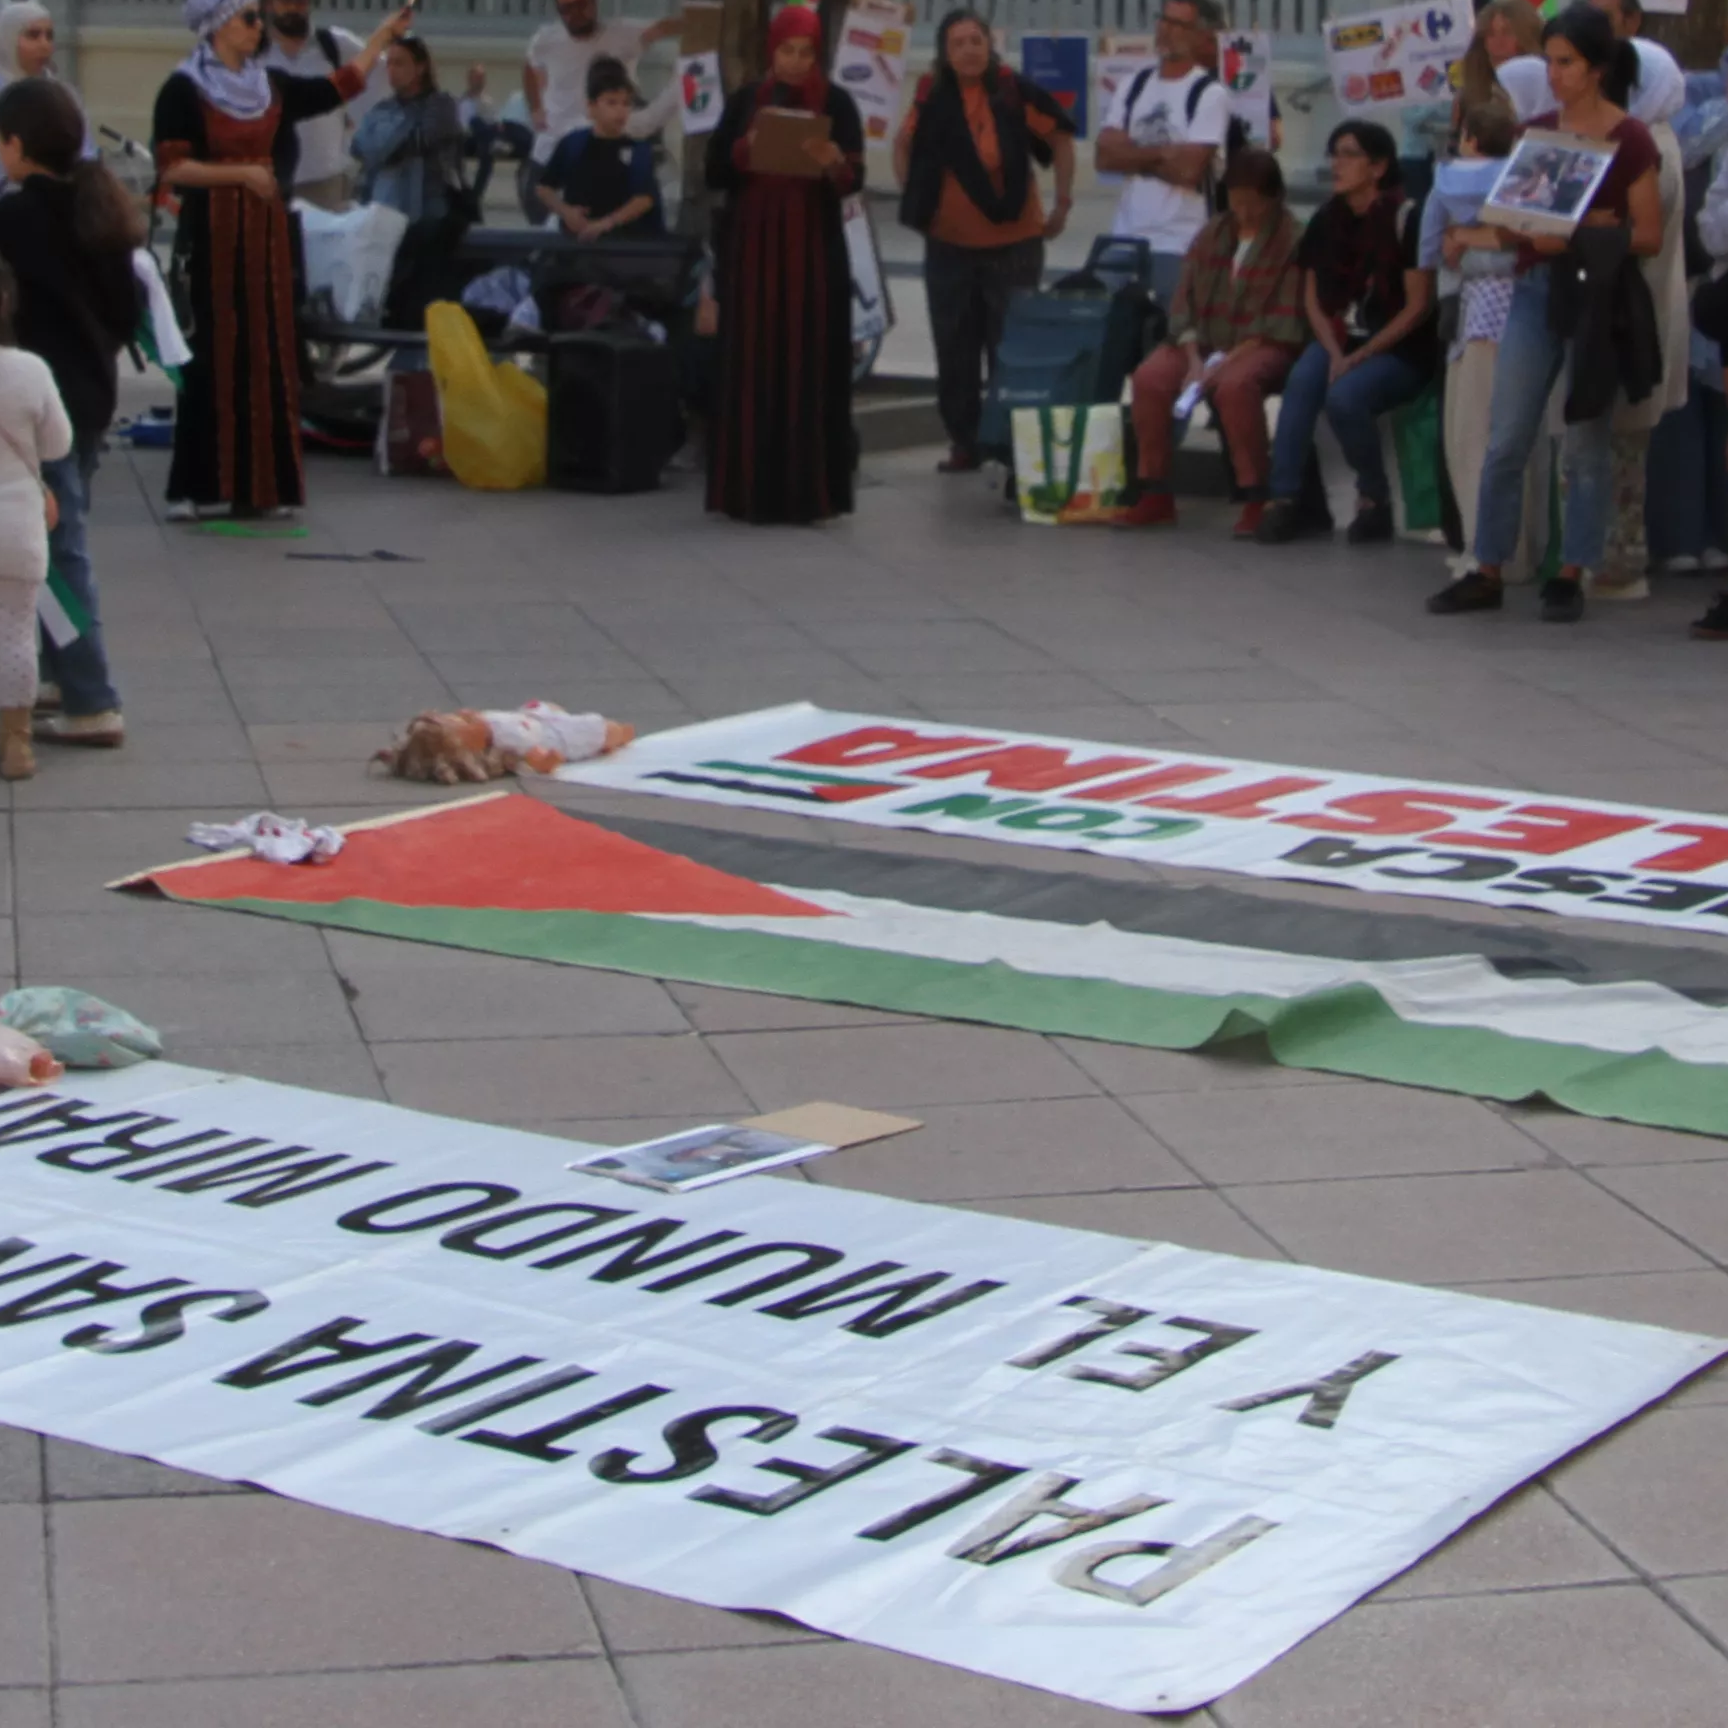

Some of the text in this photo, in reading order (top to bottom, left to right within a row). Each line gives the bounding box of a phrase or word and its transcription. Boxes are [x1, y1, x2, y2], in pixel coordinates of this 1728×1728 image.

[893, 793, 1204, 841] CON
[336, 1181, 1010, 1339] MUNDO
[1004, 1294, 1262, 1393] EL
[1216, 1349, 1403, 1430] Y
[212, 1315, 1282, 1608] PALESTINA
